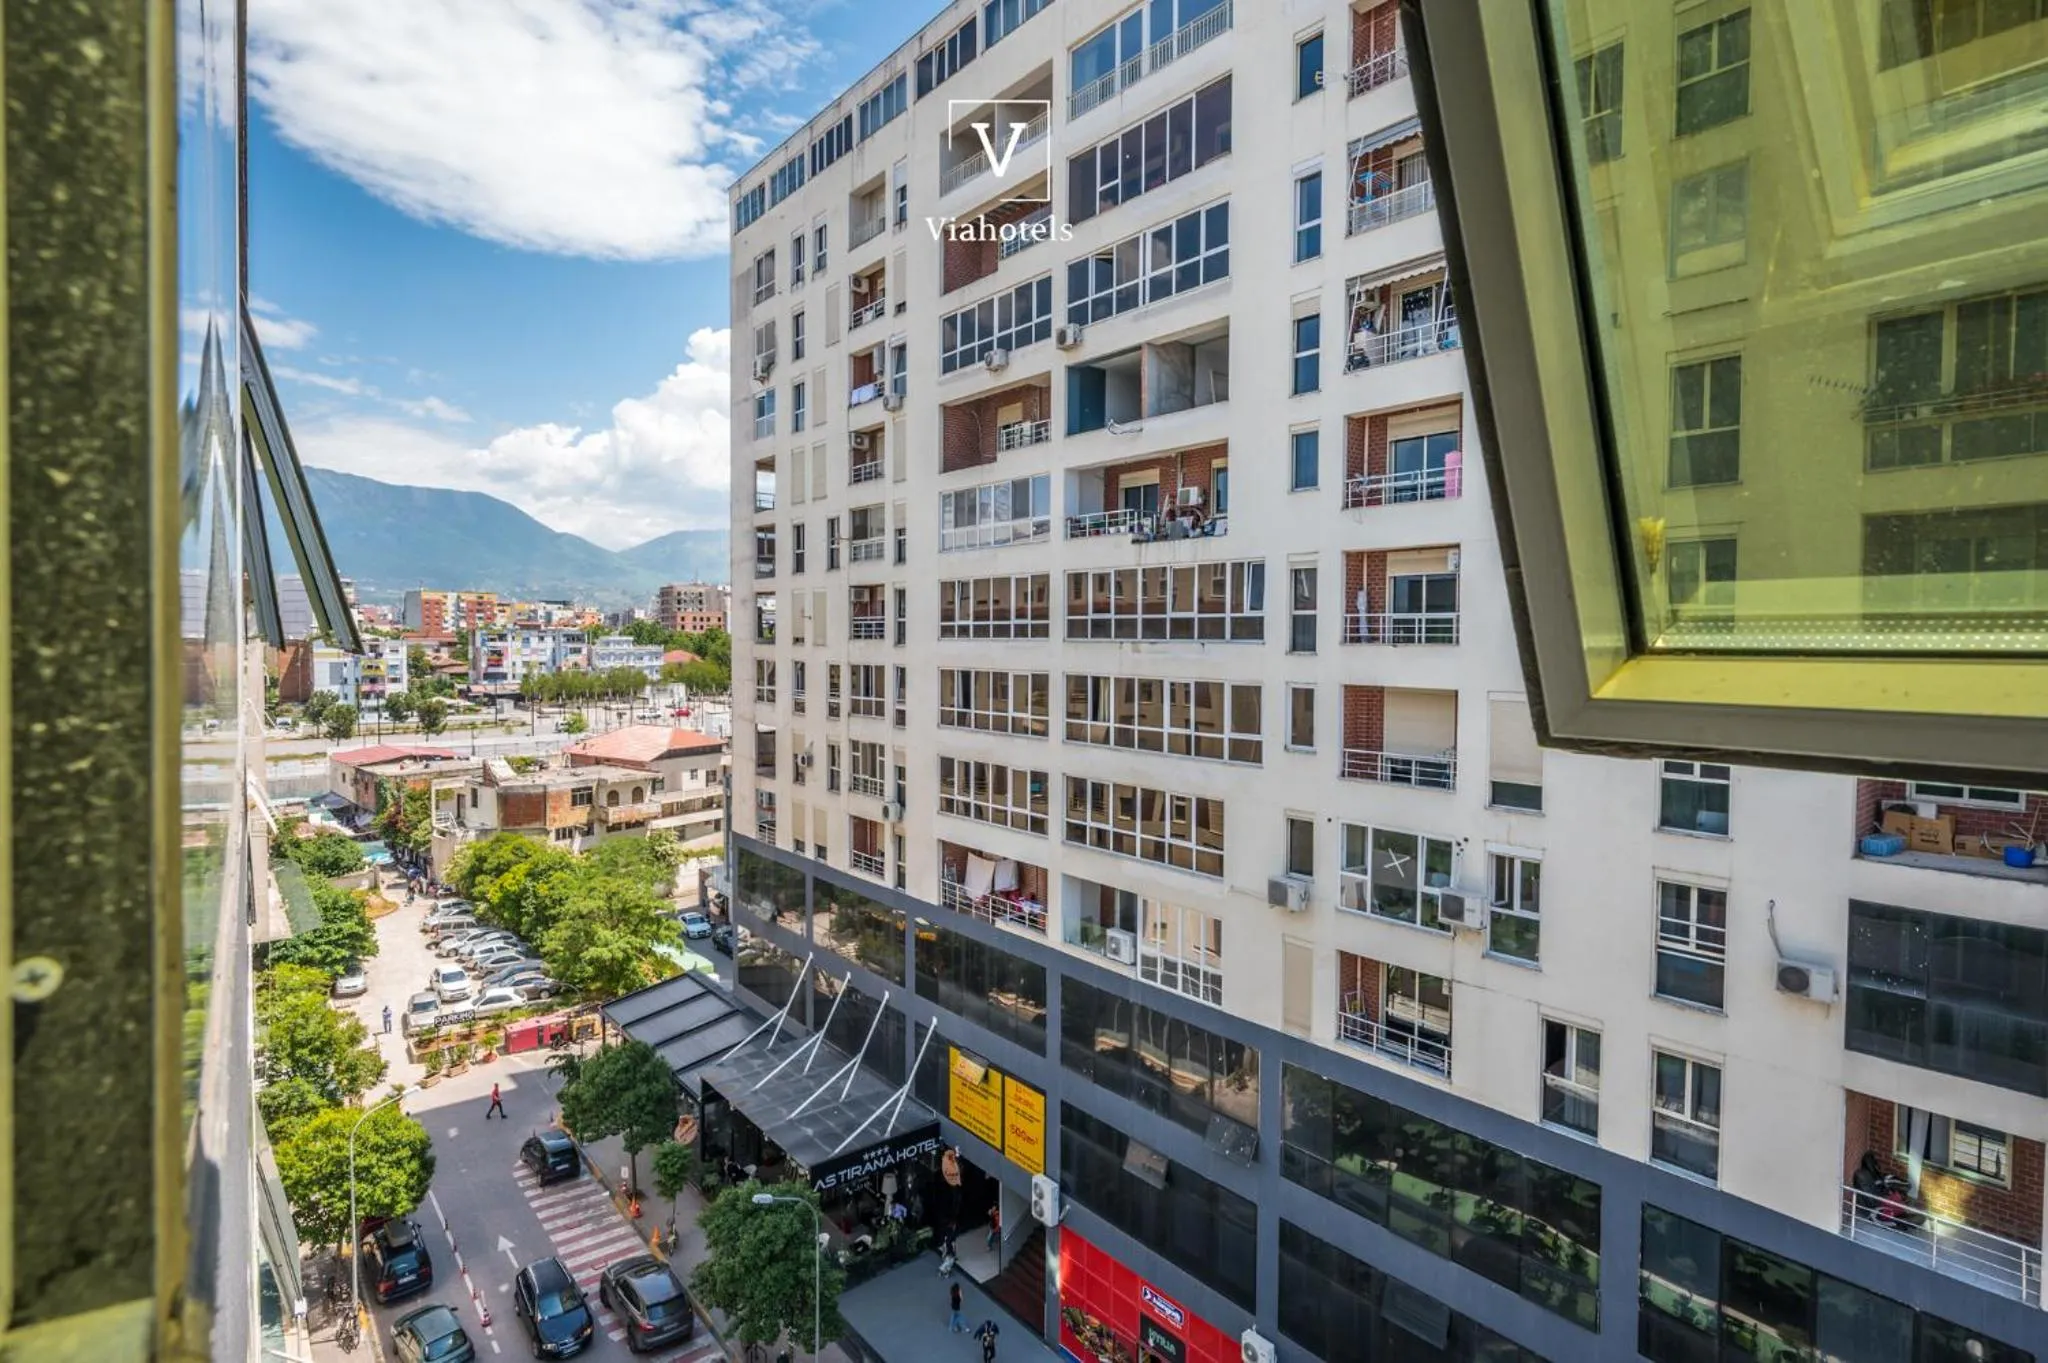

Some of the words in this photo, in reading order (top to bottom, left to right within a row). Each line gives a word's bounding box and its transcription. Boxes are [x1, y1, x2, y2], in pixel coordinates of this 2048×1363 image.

[435, 1011, 473, 1024] PARKING
[813, 1174, 837, 1192] AS
[838, 1154, 895, 1180] TIRANA
[896, 1139, 939, 1162] HOTEL
